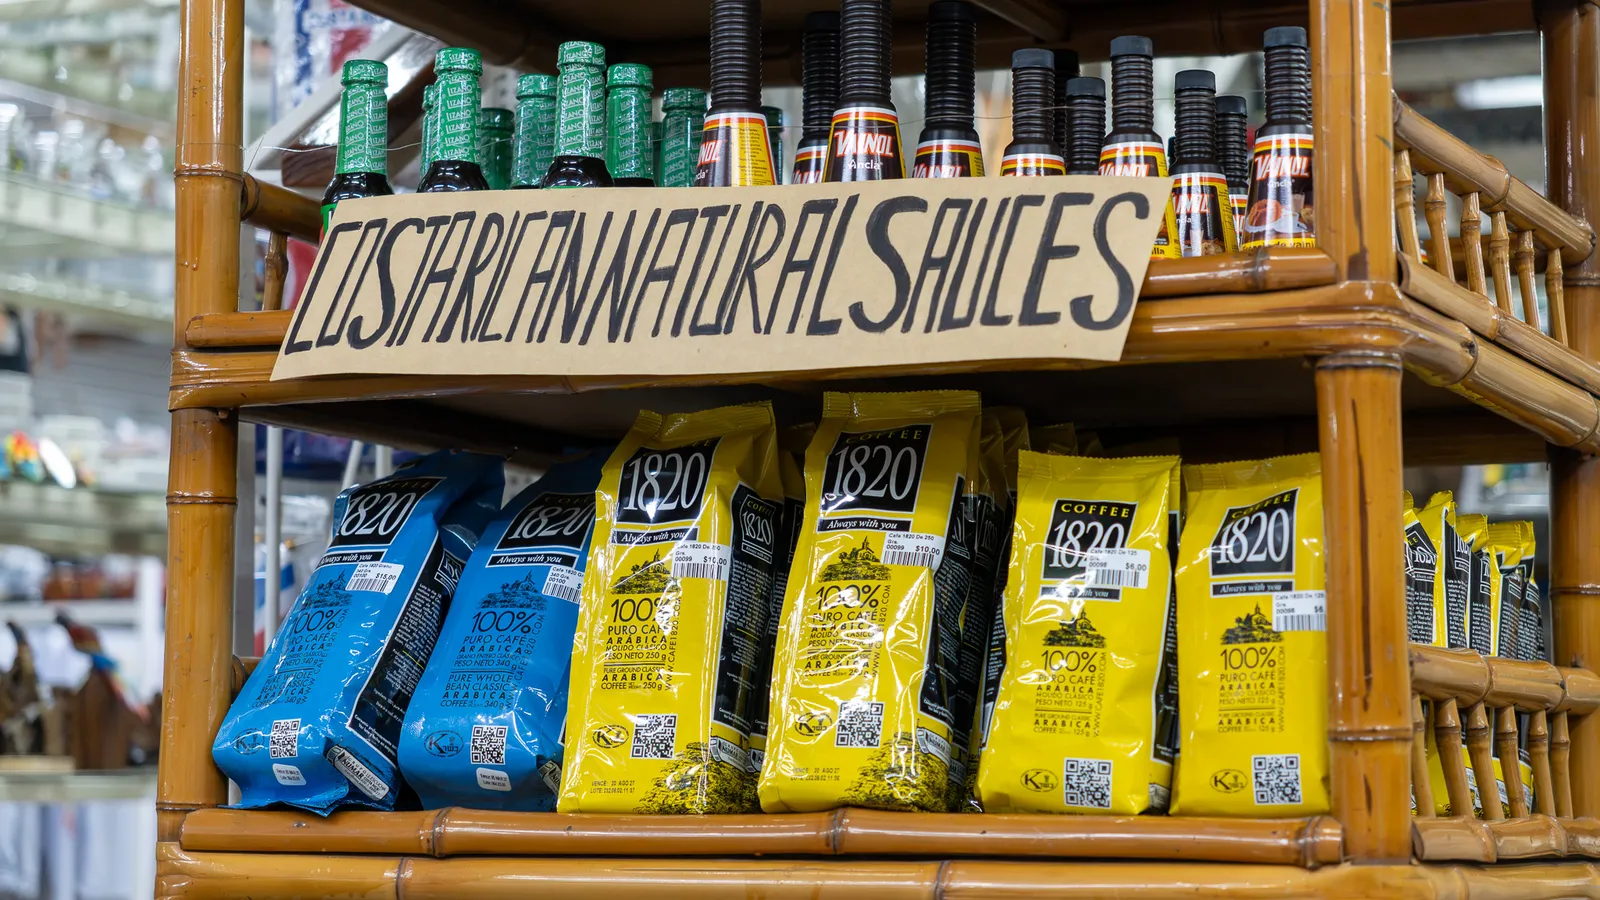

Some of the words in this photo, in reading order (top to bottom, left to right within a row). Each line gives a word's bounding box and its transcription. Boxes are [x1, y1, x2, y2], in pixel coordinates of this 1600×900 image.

[449, 73, 472, 84] LIZANO
[447, 85, 472, 96] LIZANO
[447, 97, 472, 109] LIZANO
[446, 109, 471, 121] LIZANO
[445, 122, 471, 134] LIZANO
[445, 134, 470, 146] LIZANO
[834, 130, 895, 157] VAINOL
[444, 146, 470, 158] LIZANO
[850, 159, 881, 170] Ancla
[1255, 154, 1310, 180] VAINOL
[578, 193, 860, 346] NATURAL
[848, 192, 1150, 333] SAUCES
[846, 429, 922, 444] COFFEE
[831, 445, 918, 500] 1820
[623, 452, 706, 512] 1820
[1060, 503, 1130, 518] COFFEE
[1231, 492, 1292, 519] COFFEE
[336, 492, 417, 537] 1820
[508, 501, 596, 539] 1820
[741, 510, 772, 546] 1820
[826, 519, 859, 531] Always
[860, 518, 880, 528] with
[880, 522, 899, 532] you
[621, 532, 652, 544] Always
[653, 531, 670, 541] with
[670, 531, 685, 543] you
[1216, 508, 1290, 564] 1820
[1049, 519, 1125, 568] 1820
[915, 545, 941, 556] $10.00
[342, 552, 358, 562] with
[358, 553, 373, 565] you
[496, 555, 525, 565] Always
[527, 555, 545, 563] with
[545, 555, 563, 564] you
[1125, 562, 1147, 571] $6.00
[1220, 584, 1247, 594] Always
[1248, 583, 1266, 592] with
[1267, 584, 1282, 592] you
[471, 611, 538, 635] 100%
[608, 625, 638, 636] PURO
[810, 631, 839, 639] MOLIDO
[463, 634, 493, 645] PURO
[495, 634, 525, 646] CAFÉ
[808, 639, 827, 647] PESO
[605, 644, 634, 652] MOLIDO
[645, 651, 660, 659] 250
[1041, 649, 1097, 673] 100%
[1220, 646, 1277, 671] 100%
[495, 659, 511, 667] 340
[603, 666, 616, 674] PURE
[448, 673, 473, 683] PURE
[475, 673, 514, 683] WHOLE
[602, 673, 663, 682] ARABICA
[1038, 674, 1066, 684] PURO
[1069, 673, 1096, 685] CAFÉ
[1220, 672, 1247, 683] PURO
[444, 682, 470, 691] BEAN
[471, 682, 511, 692] CLASSIC
[601, 681, 627, 690] COFFEE
[643, 682, 657, 690] 250
[442, 691, 507, 700] ARABICA
[440, 699, 469, 708] COFFEE
[1035, 698, 1053, 706] PESO
[1054, 699, 1073, 707] NETO
[1034, 719, 1091, 728] ARABICA
[1218, 717, 1276, 726] ARABICA
[1033, 726, 1057, 734] COFFEE
